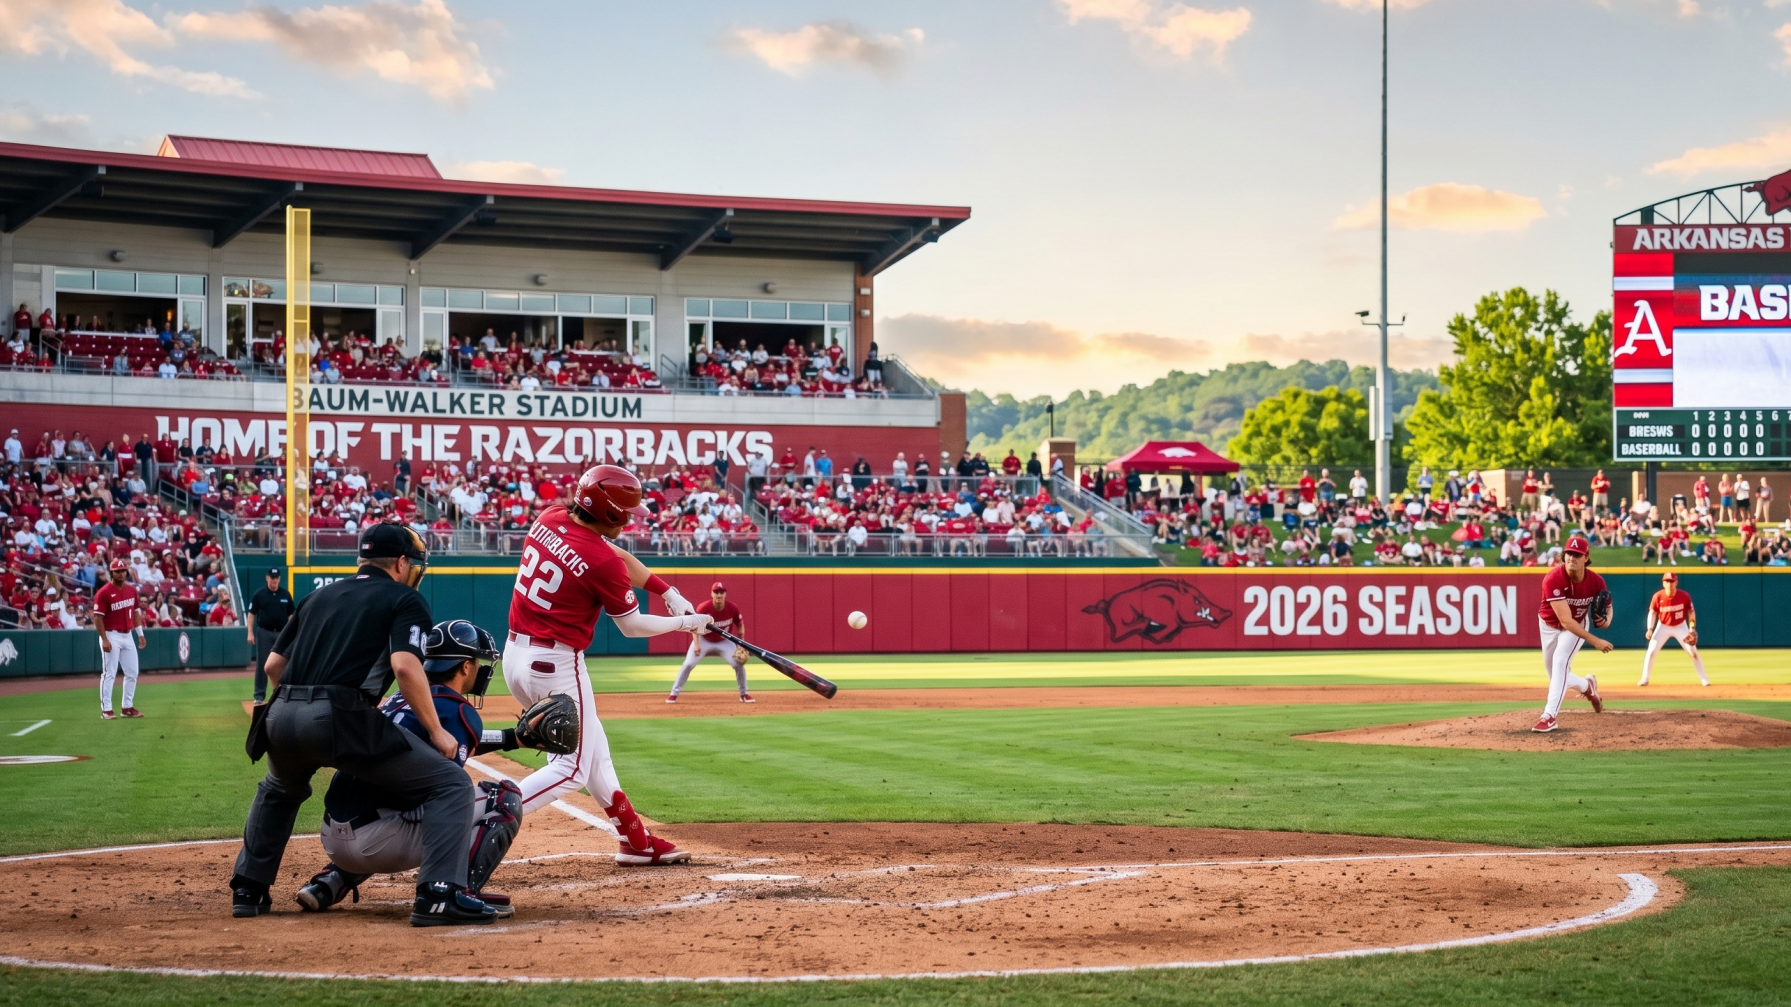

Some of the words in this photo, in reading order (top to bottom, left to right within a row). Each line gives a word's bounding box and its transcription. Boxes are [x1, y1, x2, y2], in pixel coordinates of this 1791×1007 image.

[1633, 227, 1785, 250] ARKANSAS
[1699, 284, 1791, 321] BAS
[1614, 300, 1673, 358] A
[293, 387, 504, 415] BAUM-WALKER
[516, 393, 642, 418] STADIUM
[1693, 410, 1699, 421] 1
[1708, 410, 1715, 421] 2
[1724, 410, 1731, 421] 3
[1739, 410, 1747, 421] 4
[1756, 410, 1763, 421] 5
[1771, 410, 1779, 421] 6
[155, 416, 296, 458] HOME
[308, 420, 365, 460] OF
[371, 422, 461, 461] THE
[469, 424, 774, 467] RAZORBACKS
[1628, 425, 1674, 437] BRESWS
[1691, 424, 1700, 438] 0
[1708, 424, 1716, 438] 0
[1723, 424, 1732, 438] 0
[1739, 424, 1748, 438] 0
[1755, 424, 1764, 438] 0
[1621, 443, 1682, 455] BASERBALL
[1691, 442, 1700, 456] 0
[1708, 442, 1716, 456] 0
[1723, 442, 1732, 456] 0
[1739, 442, 1748, 456] 0
[1755, 442, 1764, 456] 0
[1570, 539, 1578, 548] A
[515, 545, 563, 610] 22
[1243, 585, 1348, 636] 2026
[1358, 585, 1517, 636] SEASON
